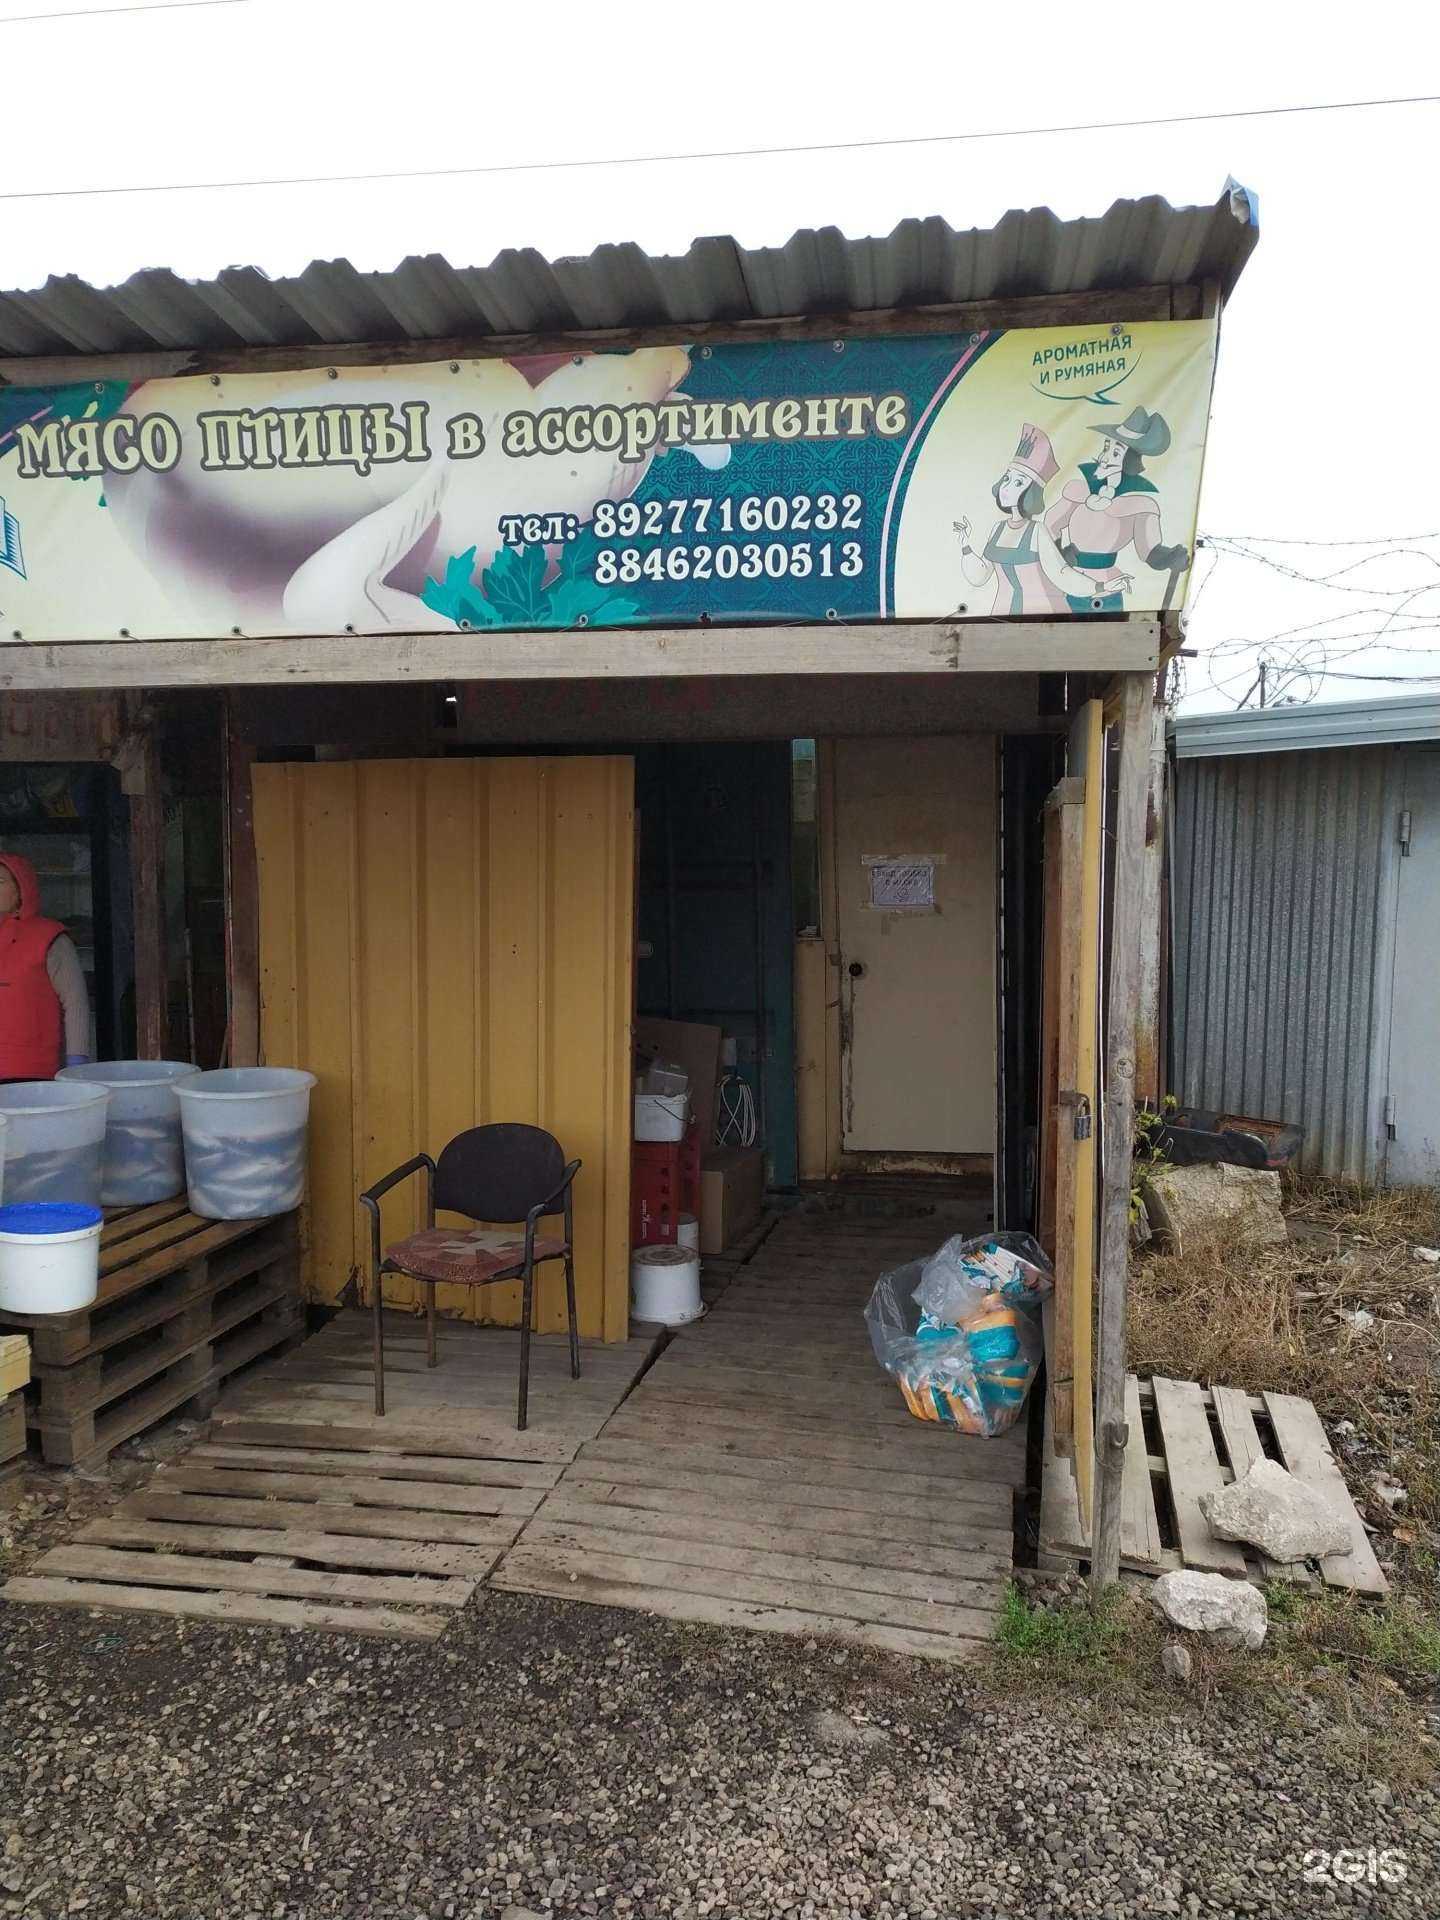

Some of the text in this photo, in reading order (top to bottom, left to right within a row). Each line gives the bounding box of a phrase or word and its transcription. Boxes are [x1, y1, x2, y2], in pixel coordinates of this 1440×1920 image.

[1033, 335, 1132, 366] АРОМАТНАЯ
[1040, 357, 1126, 385] И РУМЯНАЯ
[16, 394, 908, 476] МЯСО ПТИЦЫ в ассортименте
[501, 493, 862, 544] тел: 89277160232
[595, 541, 864, 584] 88462030513
